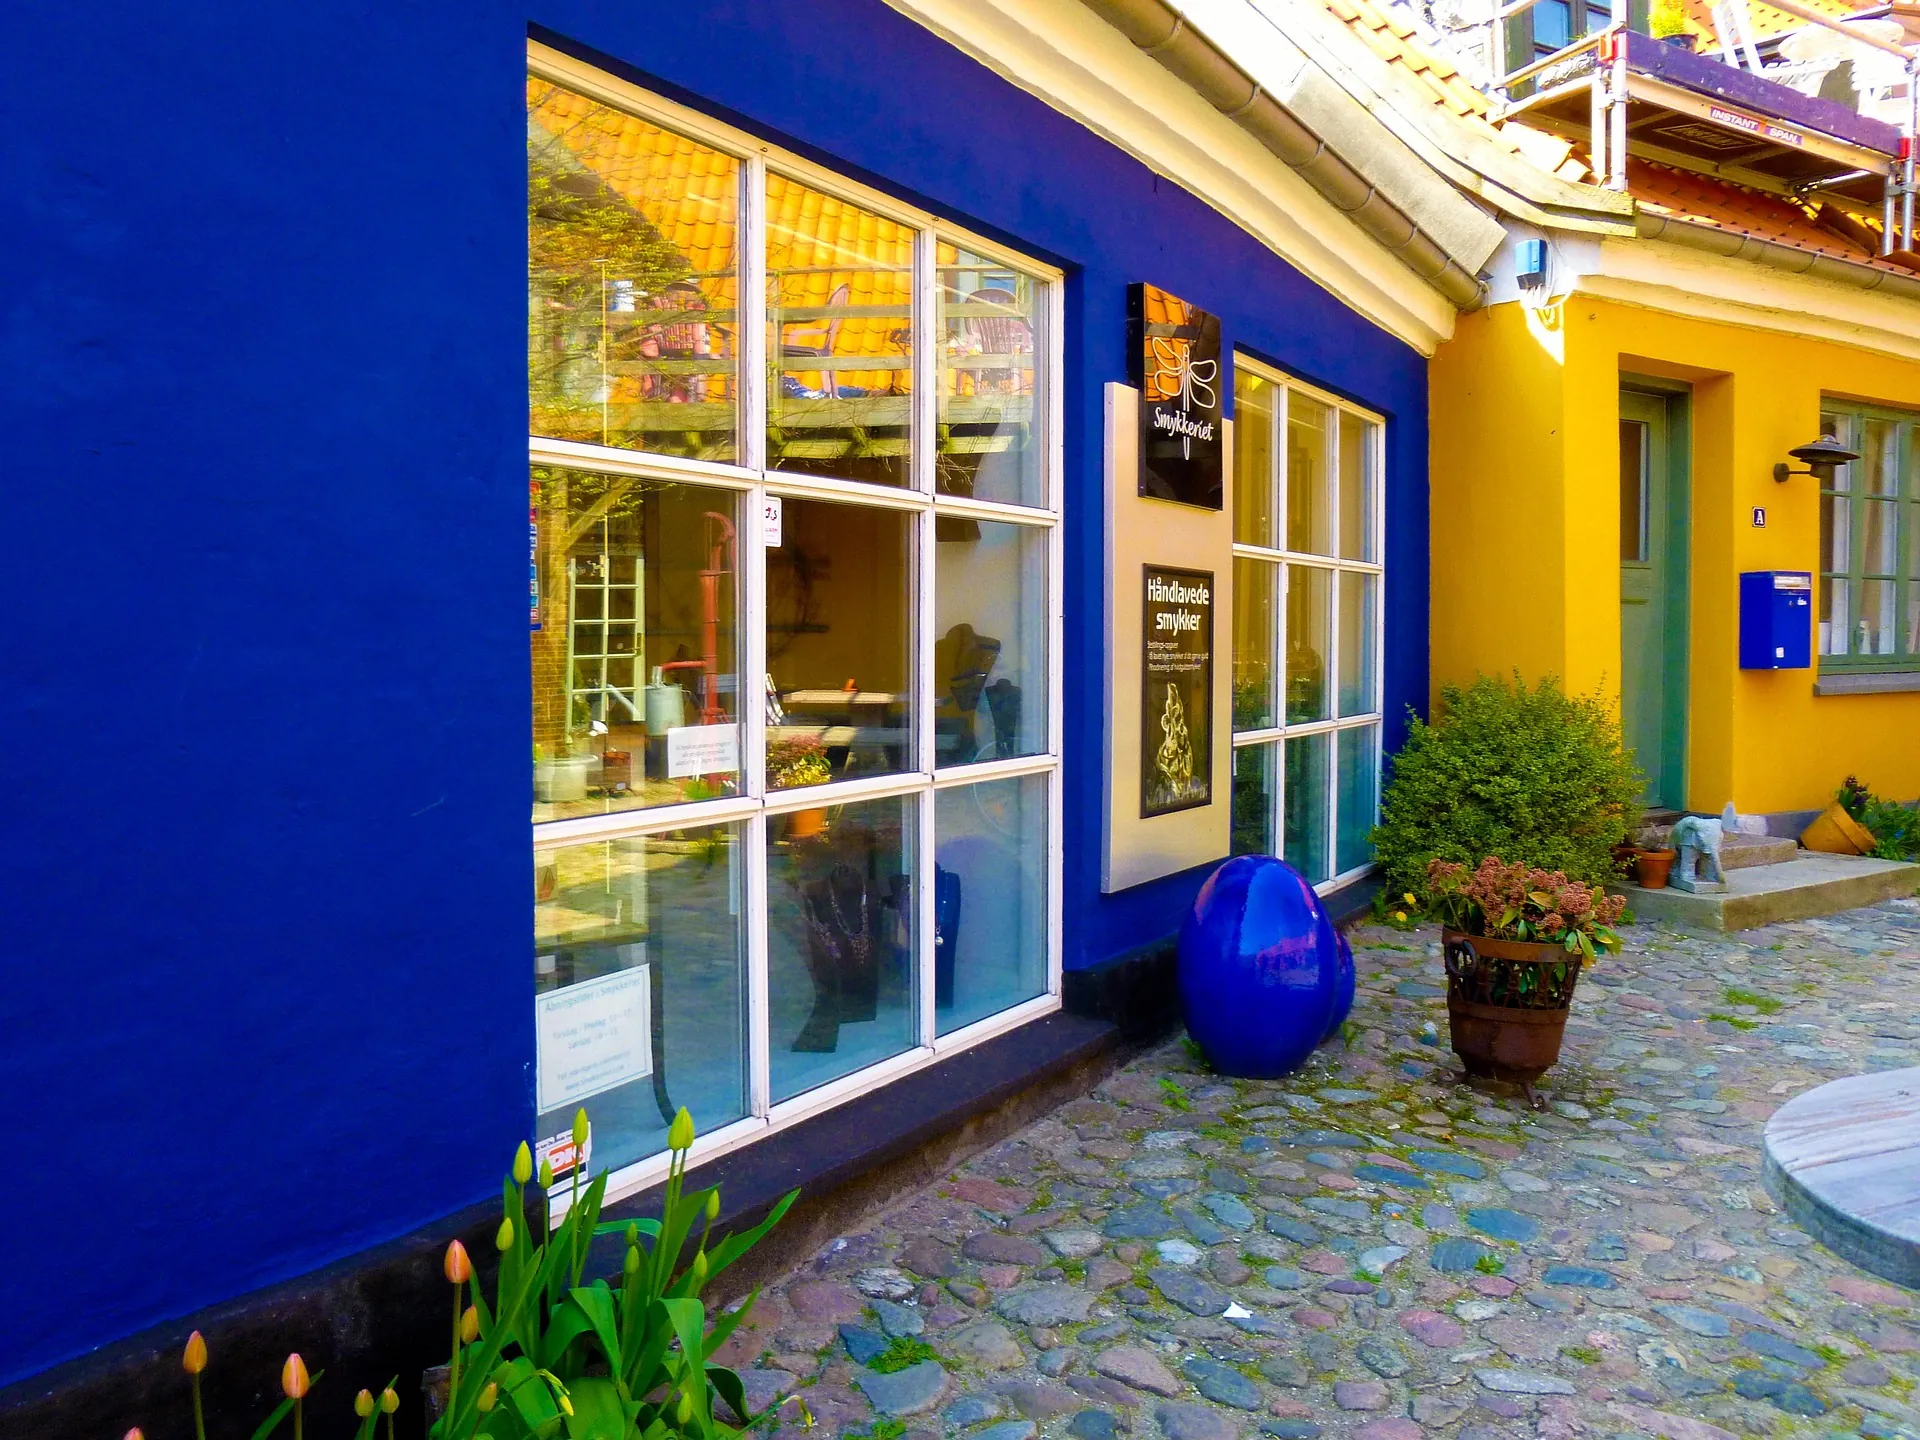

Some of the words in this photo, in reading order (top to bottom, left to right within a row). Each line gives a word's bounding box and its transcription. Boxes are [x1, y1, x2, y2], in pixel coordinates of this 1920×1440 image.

[1711, 109, 1759, 130] INSTANT
[1154, 407, 1214, 441] Smykkeriet
[1755, 510, 1764, 524] A
[1147, 577, 1209, 605] Håndlavede
[1156, 608, 1201, 636] smykker
